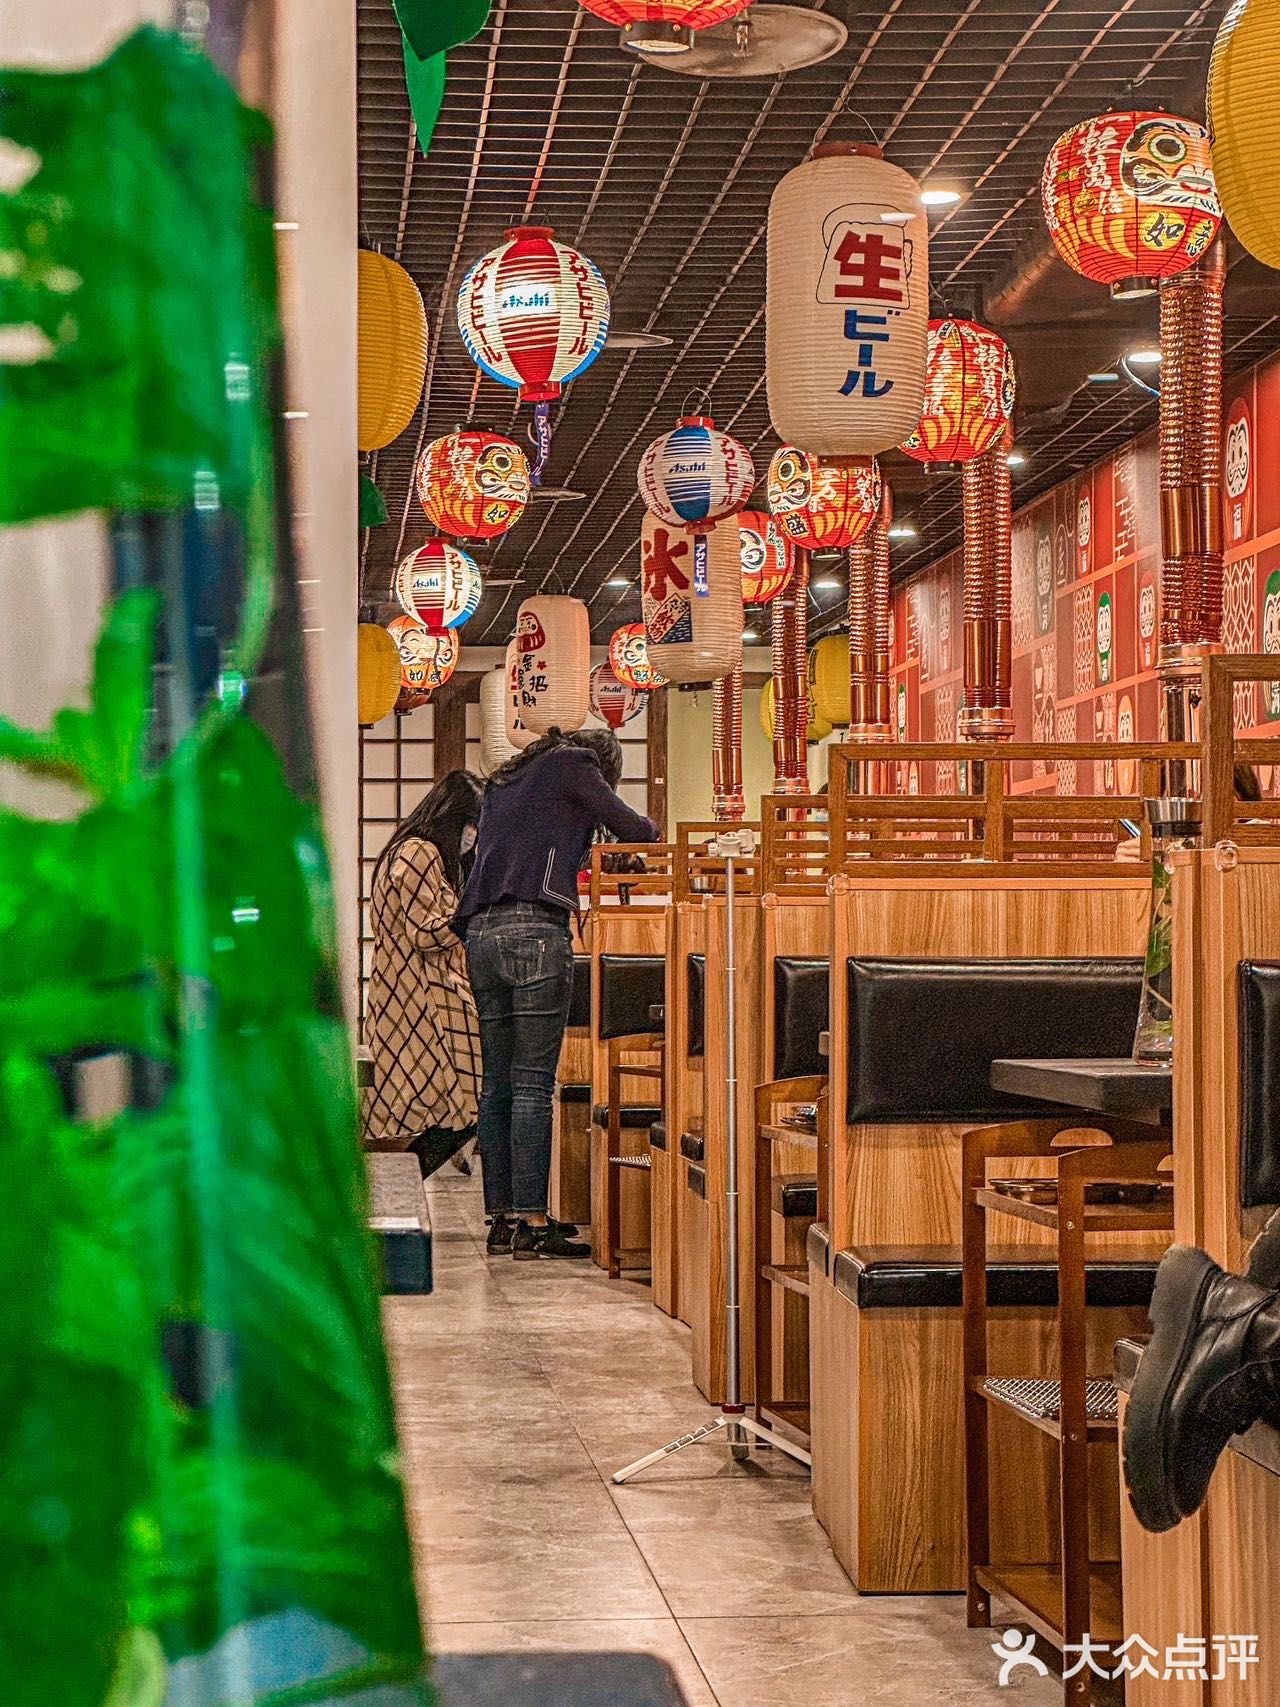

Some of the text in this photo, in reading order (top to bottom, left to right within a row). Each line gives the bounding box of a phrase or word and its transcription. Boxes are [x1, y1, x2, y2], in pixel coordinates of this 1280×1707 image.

[471, 257, 503, 364] アサヒビール
[560, 250, 594, 355] アサヒビール
[668, 461, 706, 473] Asahi
[413, 578, 438, 588] Asahi
[446, 552, 462, 611] アサヒビール
[600, 685, 622, 693] Asahi
